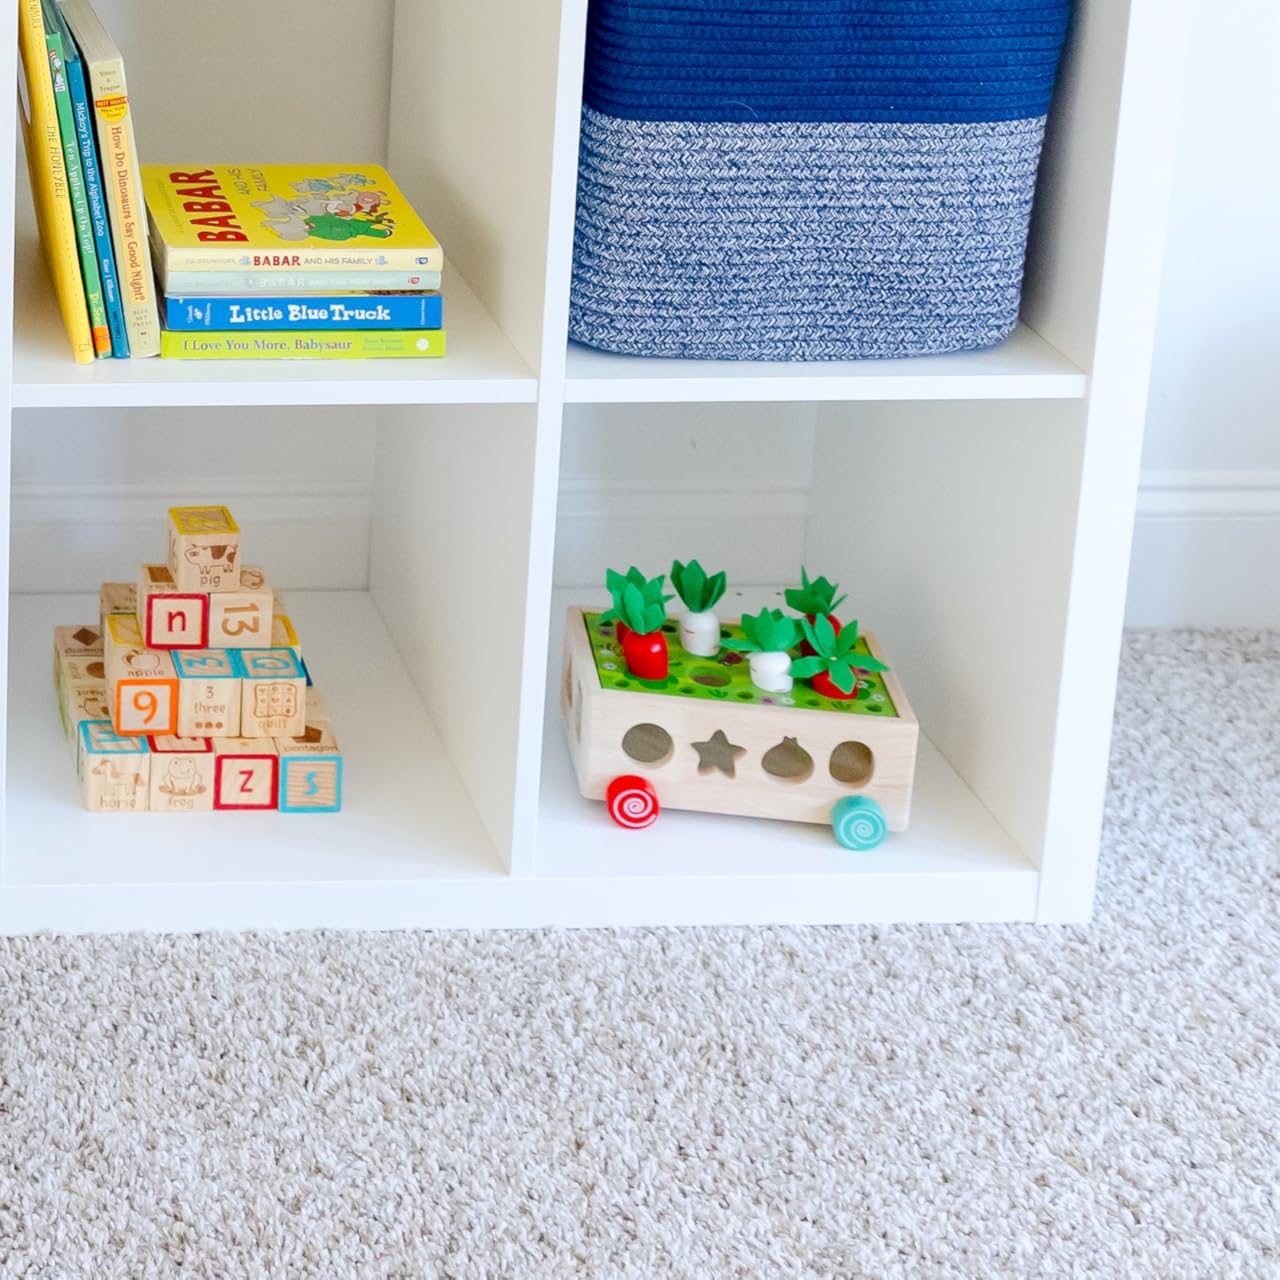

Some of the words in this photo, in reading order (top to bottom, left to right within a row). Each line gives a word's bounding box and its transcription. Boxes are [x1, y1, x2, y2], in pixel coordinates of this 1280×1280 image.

[47, 125, 57, 143] THE
[111, 126, 122, 150] How
[66, 140, 76, 160] Ten
[81, 138, 92, 157] Trip
[85, 157, 94, 168] to
[115, 151, 126, 168] Do
[48, 146, 66, 198] HONEYBEE
[68, 163, 82, 198] Apples
[87, 167, 97, 182] the
[88, 183, 102, 219] Alphabet
[117, 168, 132, 219] Dinosaurs
[169, 169, 249, 241] BABAR
[80, 216, 90, 231] On
[95, 219, 105, 237] Zoo
[123, 221, 135, 239] Say
[127, 241, 141, 269] Good
[253, 255, 301, 266] BABAR
[304, 257, 323, 265] AND
[324, 257, 340, 265] HIS
[341, 257, 373, 265] FAMILY
[130, 271, 146, 302] Night?
[229, 304, 283, 323] Little
[287, 304, 328, 321] Blue
[329, 304, 391, 321] Truck
[192, 340, 222, 351] Love
[226, 340, 249, 351] You
[253, 339, 291, 352] More,
[294, 338, 352, 353] Babysaur
[200, 574, 222, 588] pig
[167, 610, 187, 633] n
[221, 603, 260, 637] 13
[127, 669, 166, 678] apple
[205, 685, 215, 699] 3
[132, 690, 159, 726] 9
[193, 701, 226, 714] three
[99, 795, 137, 809] horse
[167, 797, 195, 810] frog
